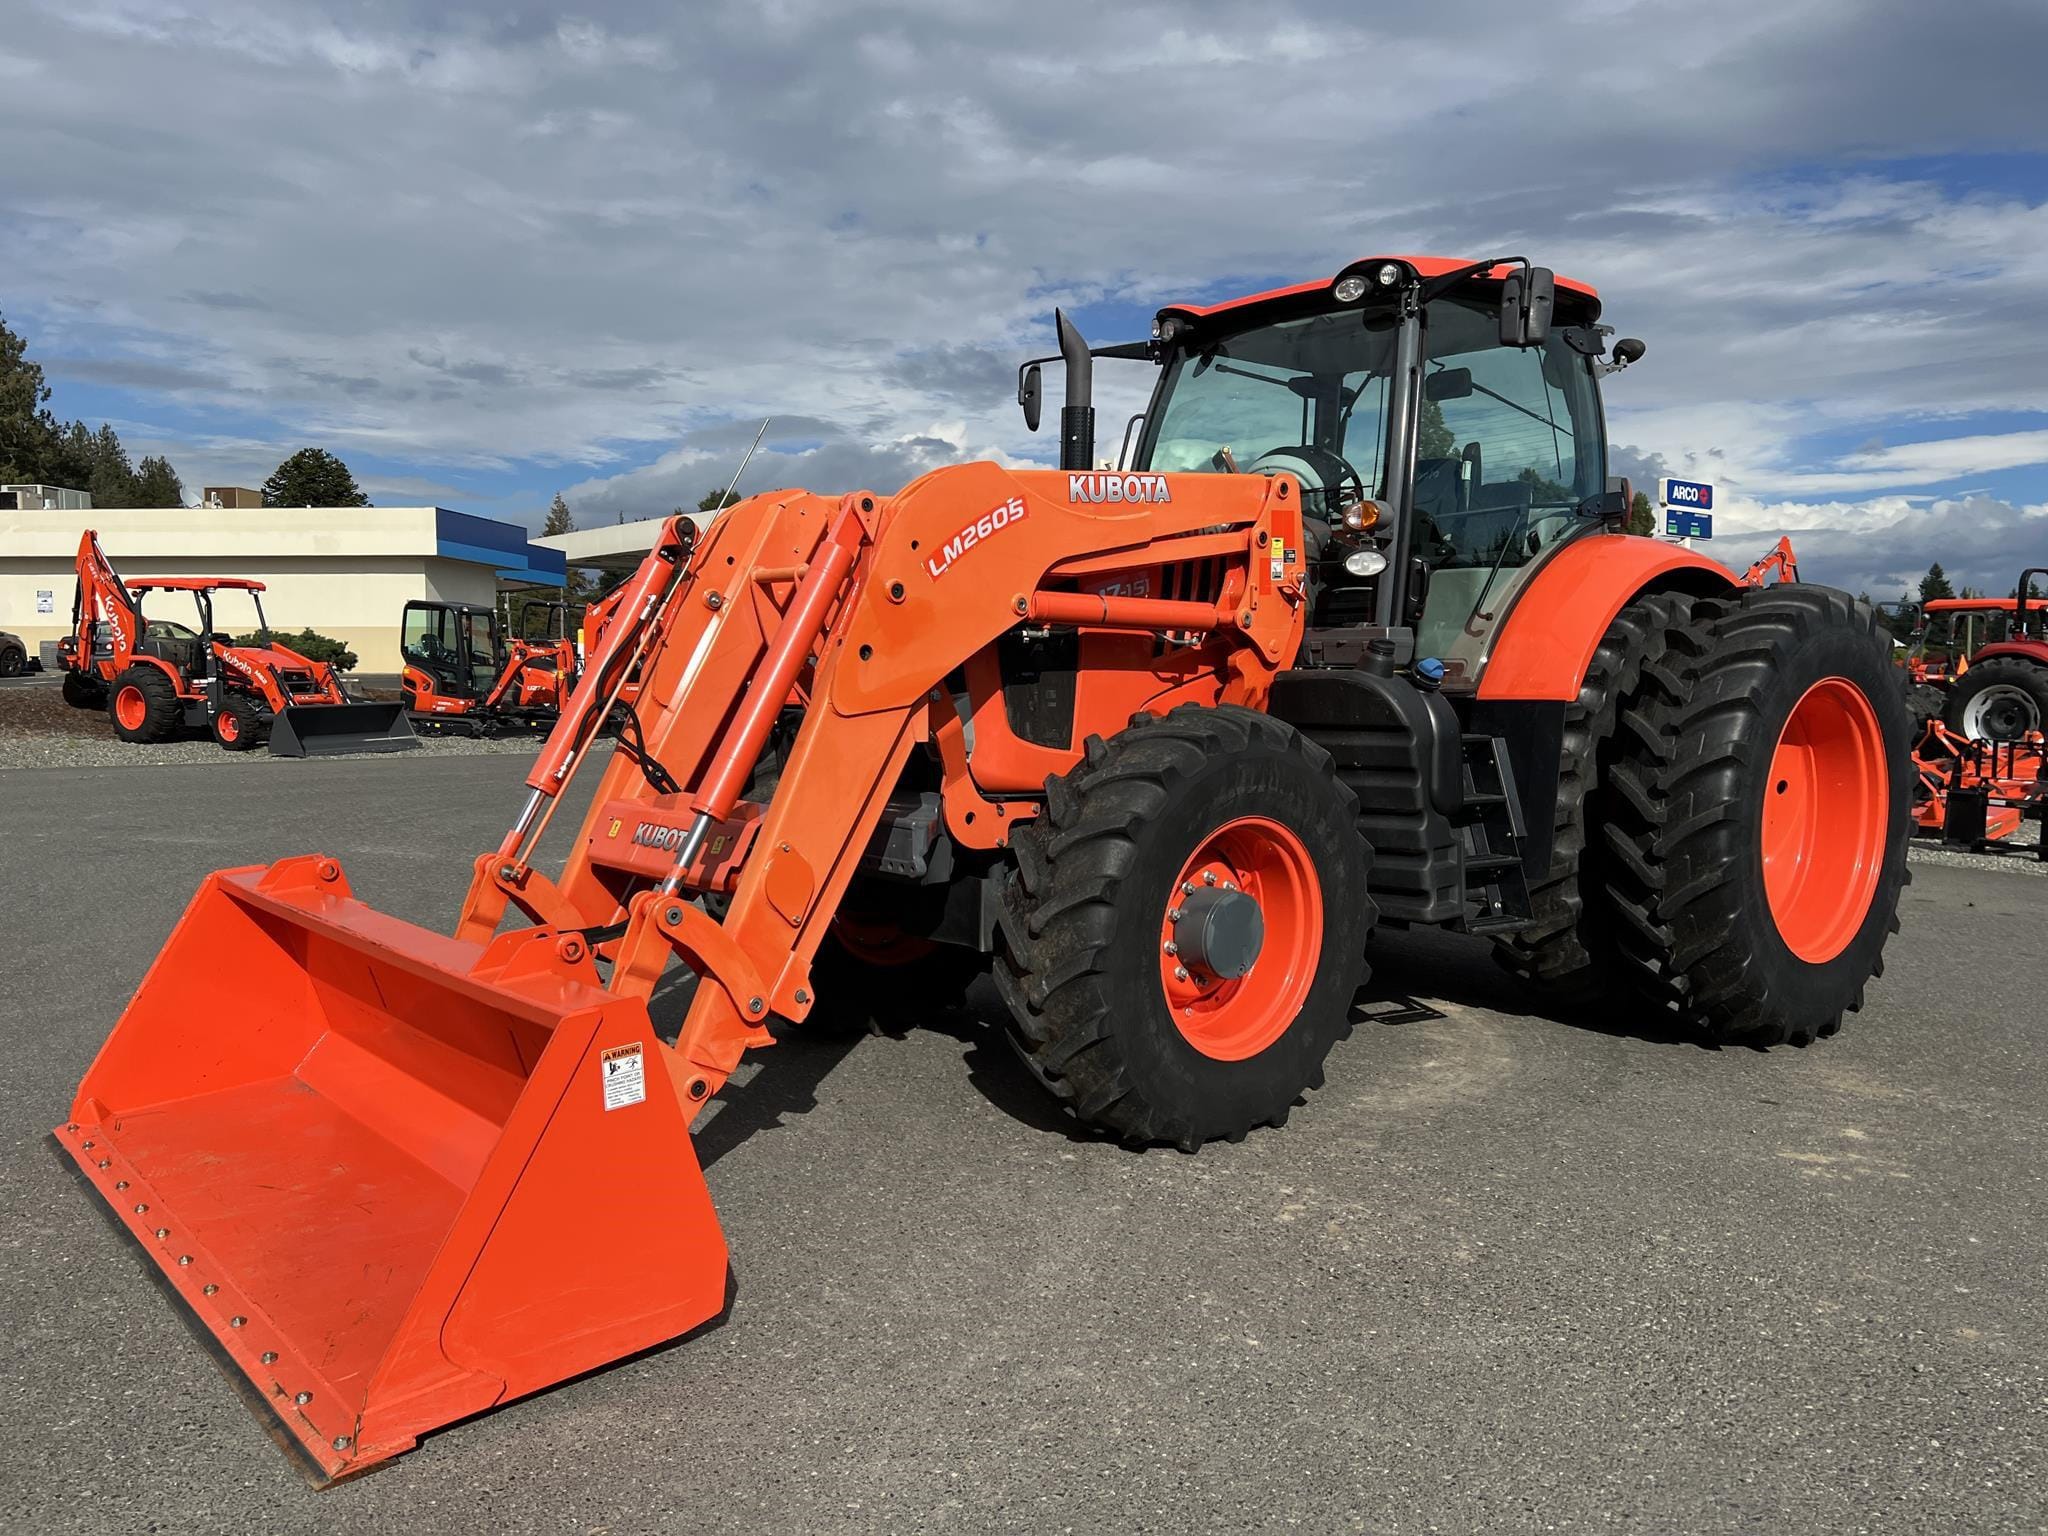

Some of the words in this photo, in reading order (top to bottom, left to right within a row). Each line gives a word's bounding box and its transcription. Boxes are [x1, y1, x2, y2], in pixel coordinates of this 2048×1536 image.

[1068, 474, 1171, 503] KUBOTA
[1672, 485, 1698, 502] ARCO
[928, 498, 1024, 576] LM2605
[1098, 578, 1150, 598] 7-151
[105, 596, 126, 652] Kubota
[223, 650, 252, 674] Kubota
[632, 822, 689, 853] KUBOT
[611, 1045, 640, 1059] WARNING
